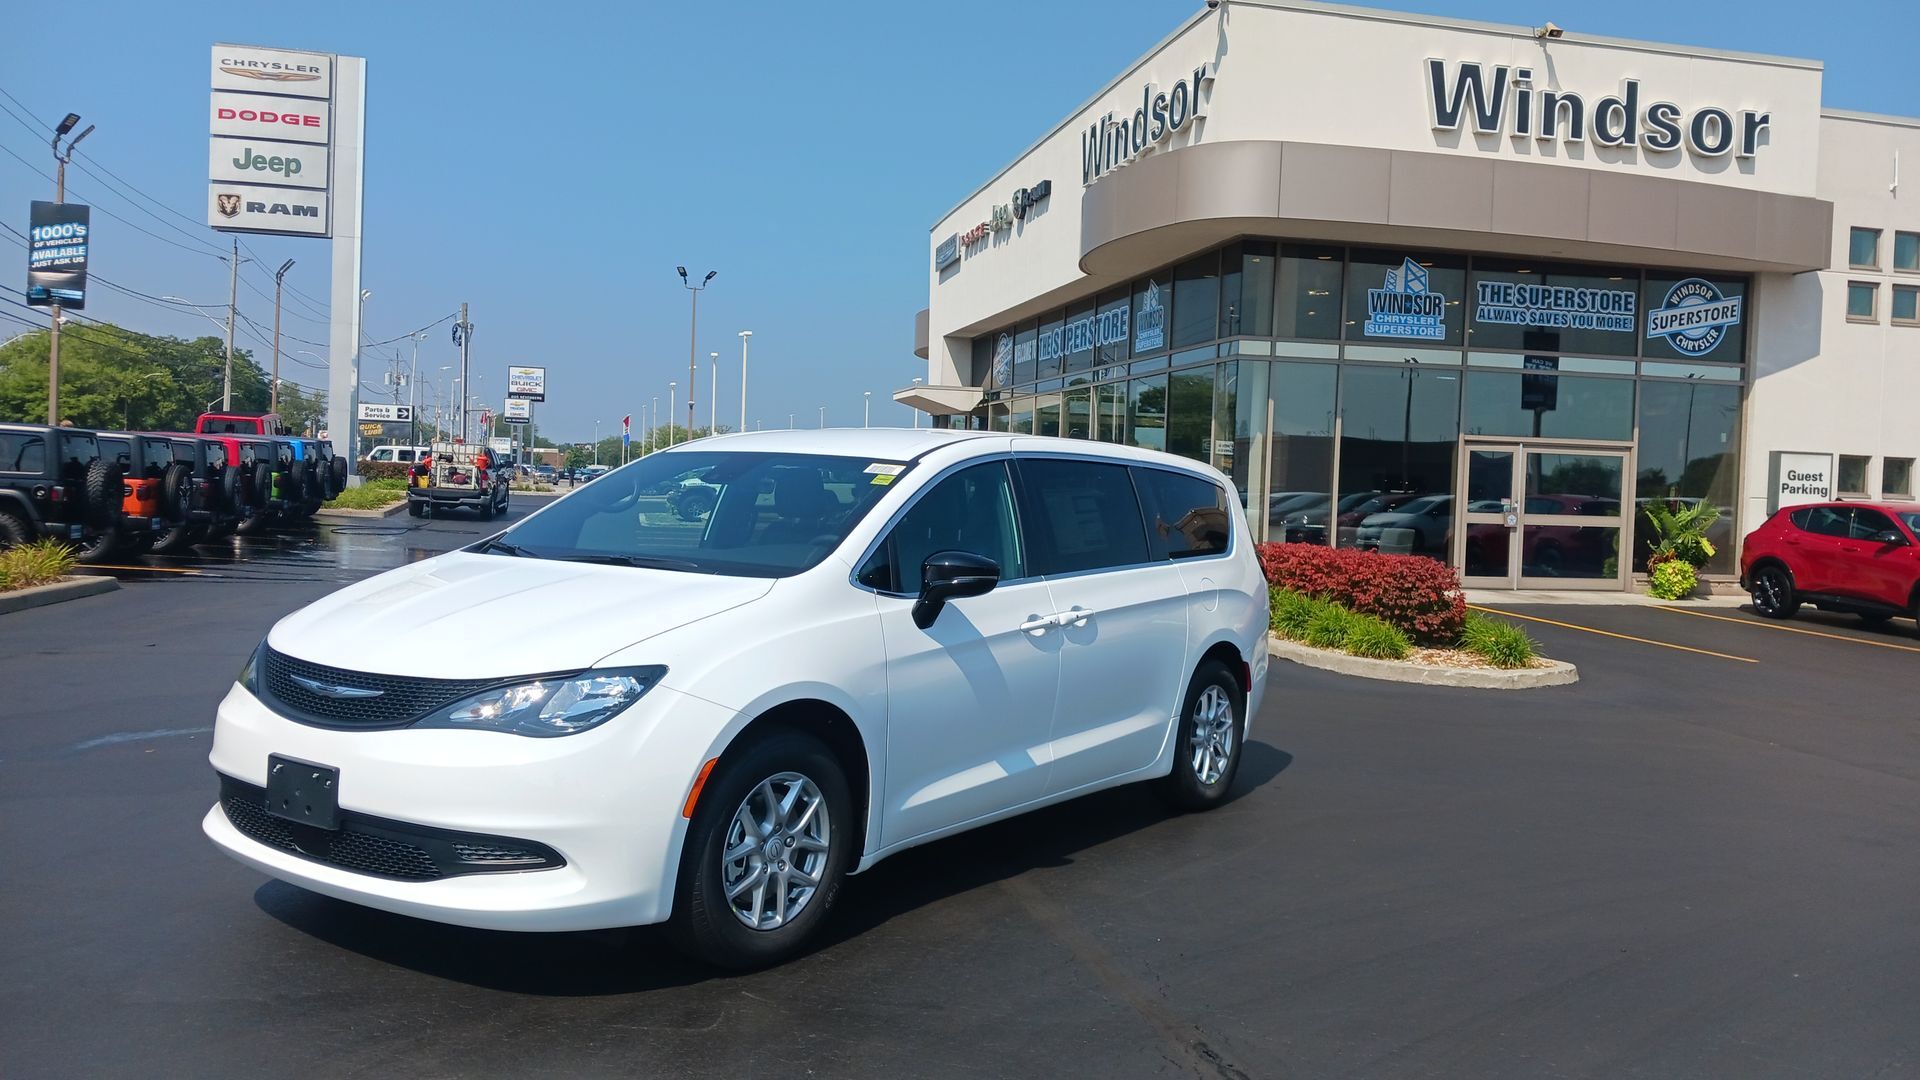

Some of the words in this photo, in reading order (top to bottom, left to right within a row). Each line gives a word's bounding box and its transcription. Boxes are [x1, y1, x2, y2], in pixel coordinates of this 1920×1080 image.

[221, 58, 321, 73] CHRYSLER
[1424, 57, 1771, 158] Windsor
[218, 108, 321, 127] DODGE
[1081, 62, 1211, 187] Windsor
[232, 147, 302, 178] Jeep
[246, 201, 318, 217] RAM
[32, 223, 87, 240] 1000's
[46, 237, 83, 247] VEHICLES
[31, 246, 86, 261] AVAILABLE
[31, 260, 51, 268] JUST
[53, 257, 71, 266] ASK
[1370, 292, 1441, 316] WINDSOR
[1478, 283, 1514, 305] THE
[1515, 285, 1635, 314] SUPERSTORE
[1670, 284, 1713, 305] WINDSOR
[1376, 315, 1435, 325] CHRYSLER
[1478, 307, 1527, 323] ALWAYS
[1529, 311, 1568, 326] SAVES
[1568, 315, 1596, 328] YOU
[1596, 315, 1633, 330] MORE!
[1651, 304, 1737, 331] SUPERSTORE
[1051, 306, 1129, 359] SUPERSTORE
[1368, 324, 1442, 336] SUPERSTORE
[1676, 329, 1719, 351] CHRYSLER
[1787, 469, 1823, 482] Guest
[1781, 483, 1828, 498] Parking
